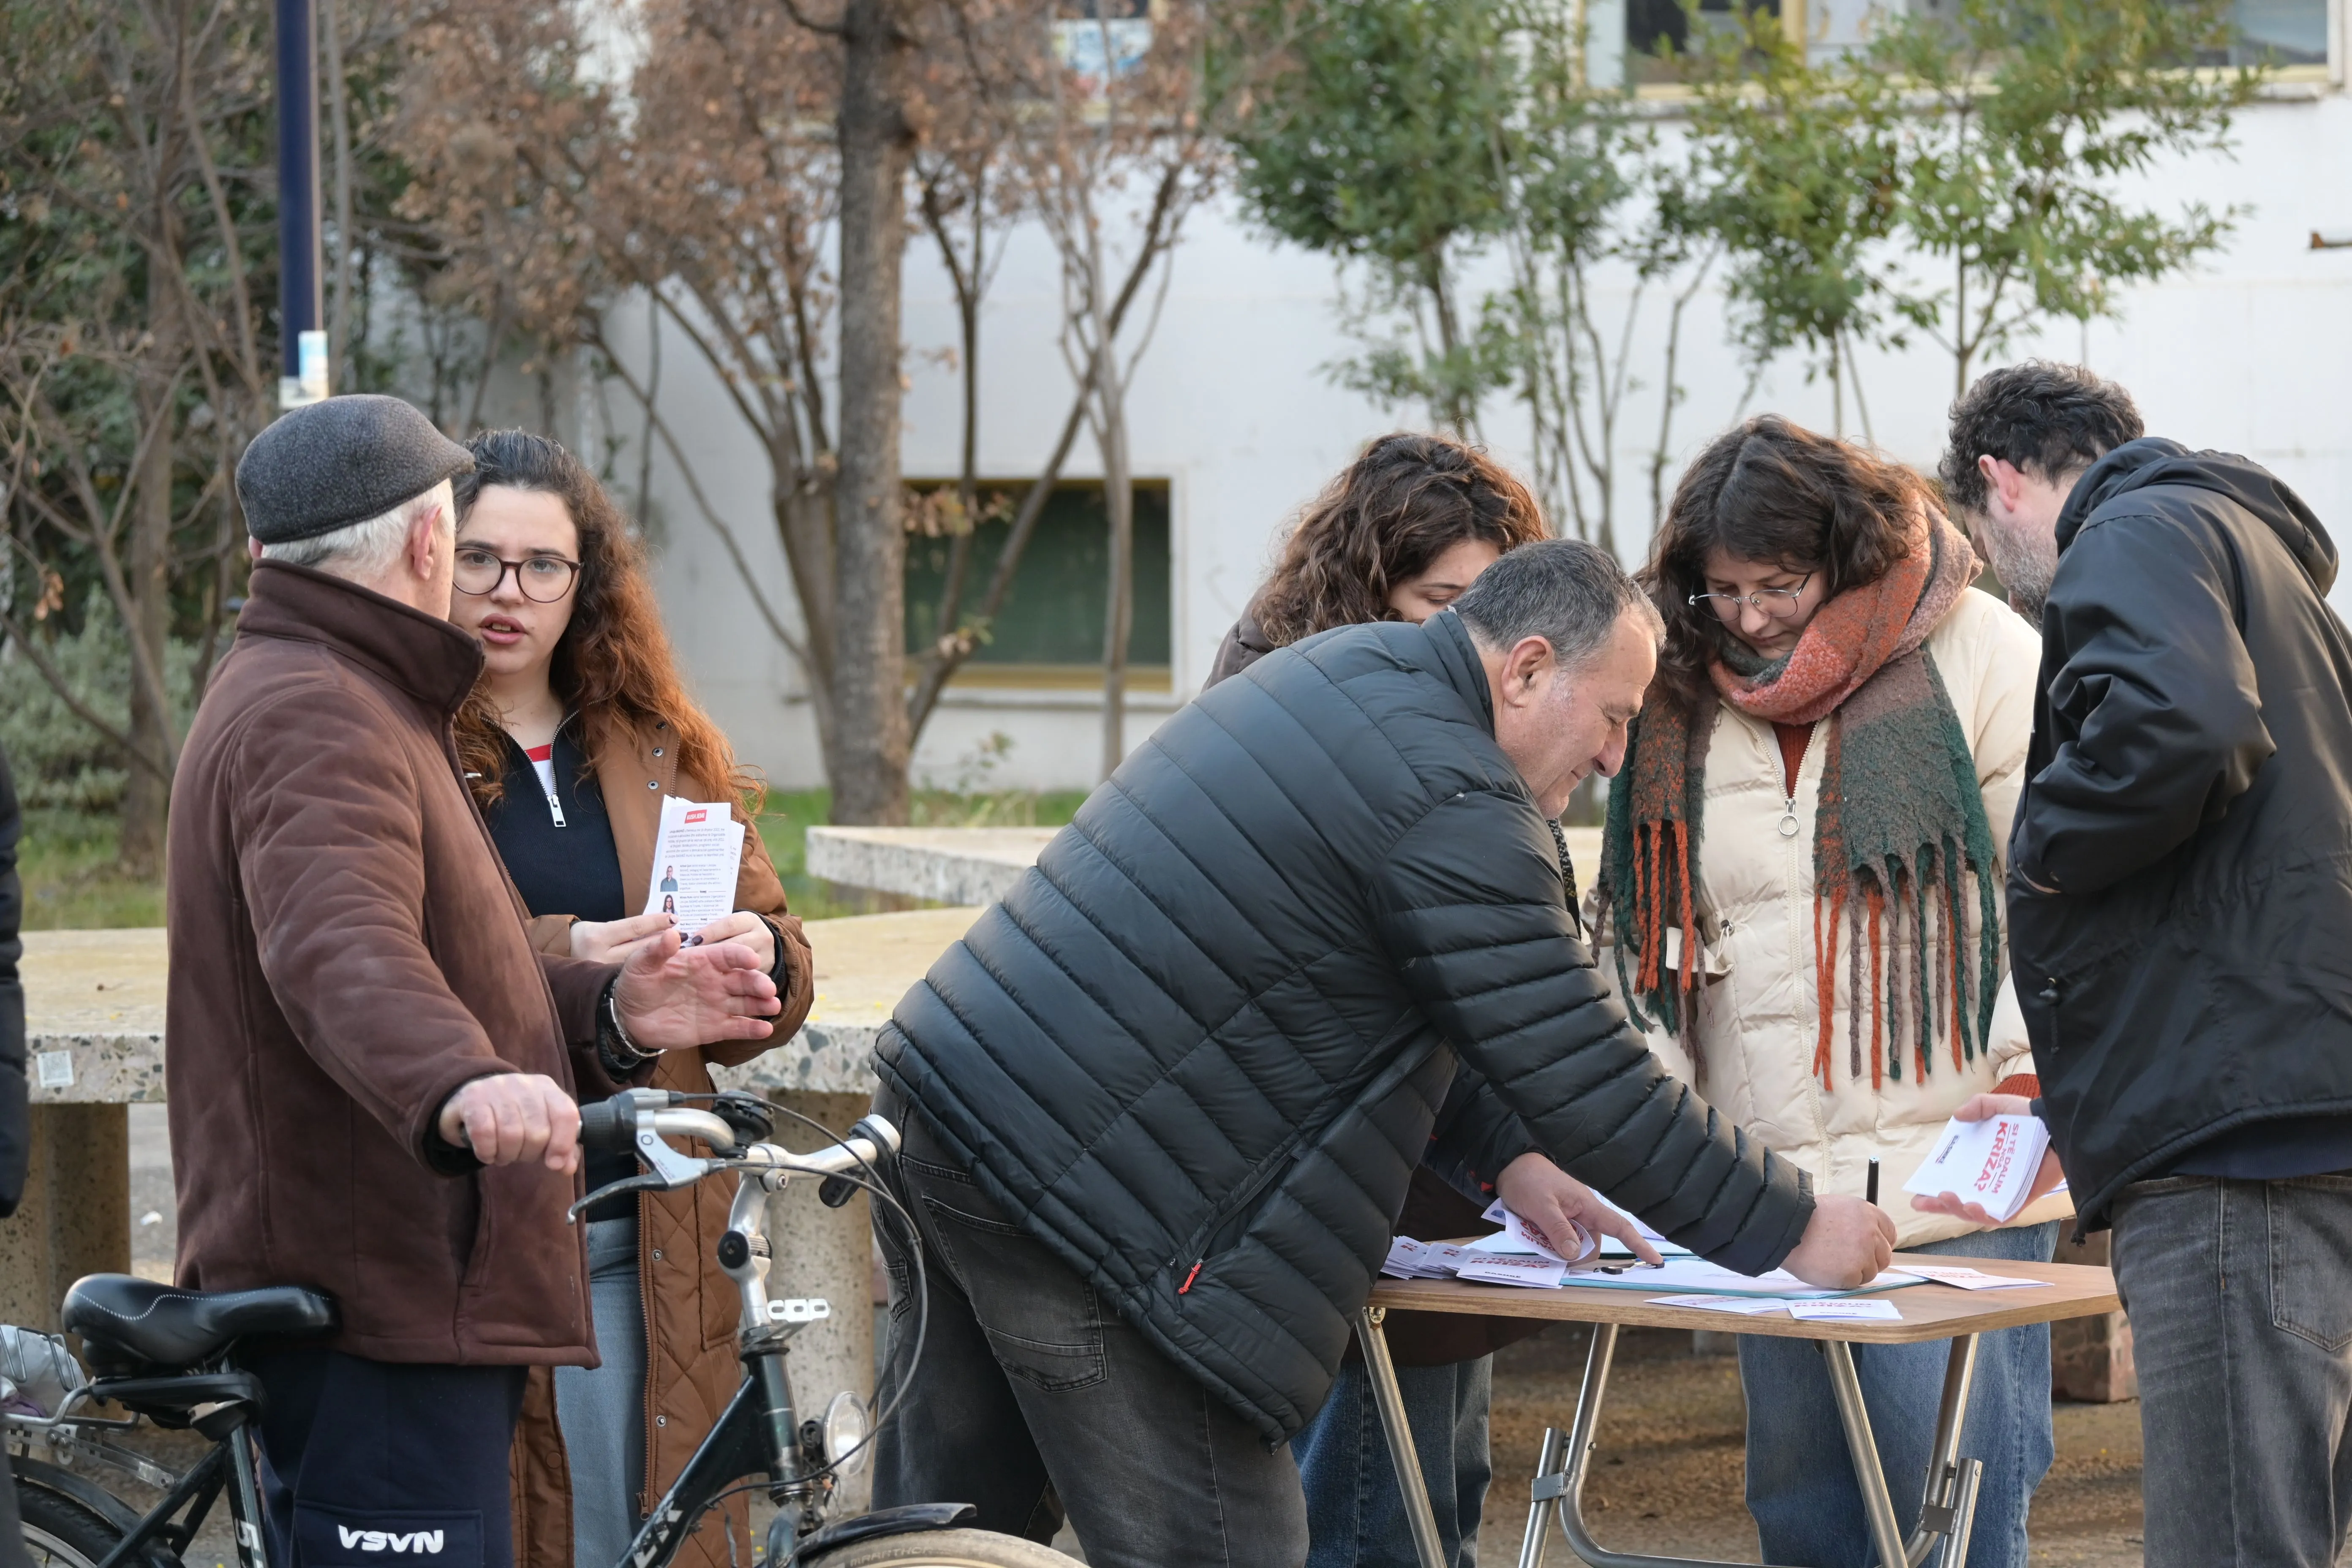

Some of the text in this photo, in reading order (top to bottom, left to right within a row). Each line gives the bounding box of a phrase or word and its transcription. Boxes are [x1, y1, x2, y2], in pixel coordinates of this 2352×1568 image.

[1974, 1121, 2009, 1192] KRIZA?
[1991, 1122, 2020, 1194] SI TË DALIM
[1996, 1148, 2007, 1169] NGA
[1470, 1260, 1549, 1269] KRIZA?
